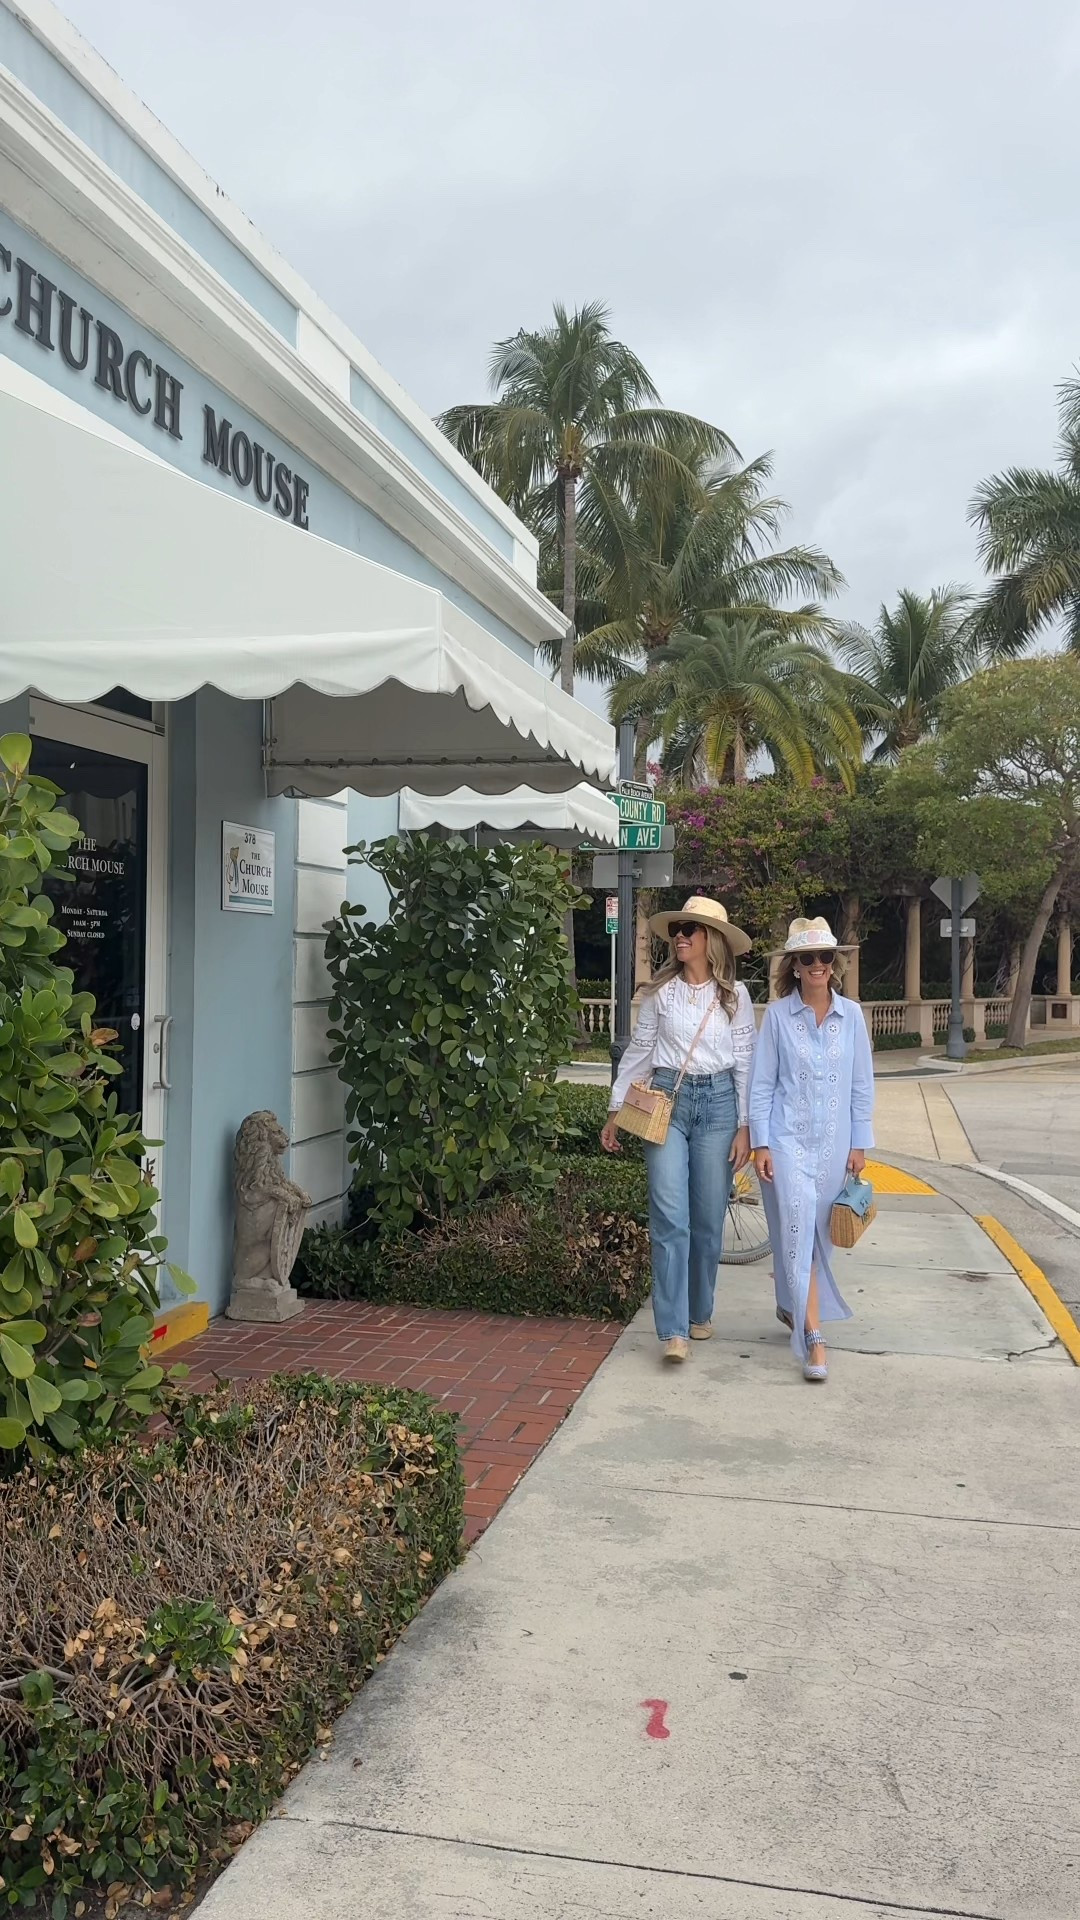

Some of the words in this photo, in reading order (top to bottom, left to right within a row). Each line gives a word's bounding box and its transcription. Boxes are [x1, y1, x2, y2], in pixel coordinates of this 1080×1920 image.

[203, 404, 310, 531] MOUSE
[620, 799, 648, 820] COUNTY
[652, 804, 661, 822] RD
[78, 838, 96, 851] THE
[244, 832, 256, 845] 378
[636, 828, 656, 846] AVE
[251, 852, 260, 860] THE
[92, 859, 124, 874] MOUSE
[240, 859, 272, 877] CHURCH
[242, 879, 268, 895] MOUSE
